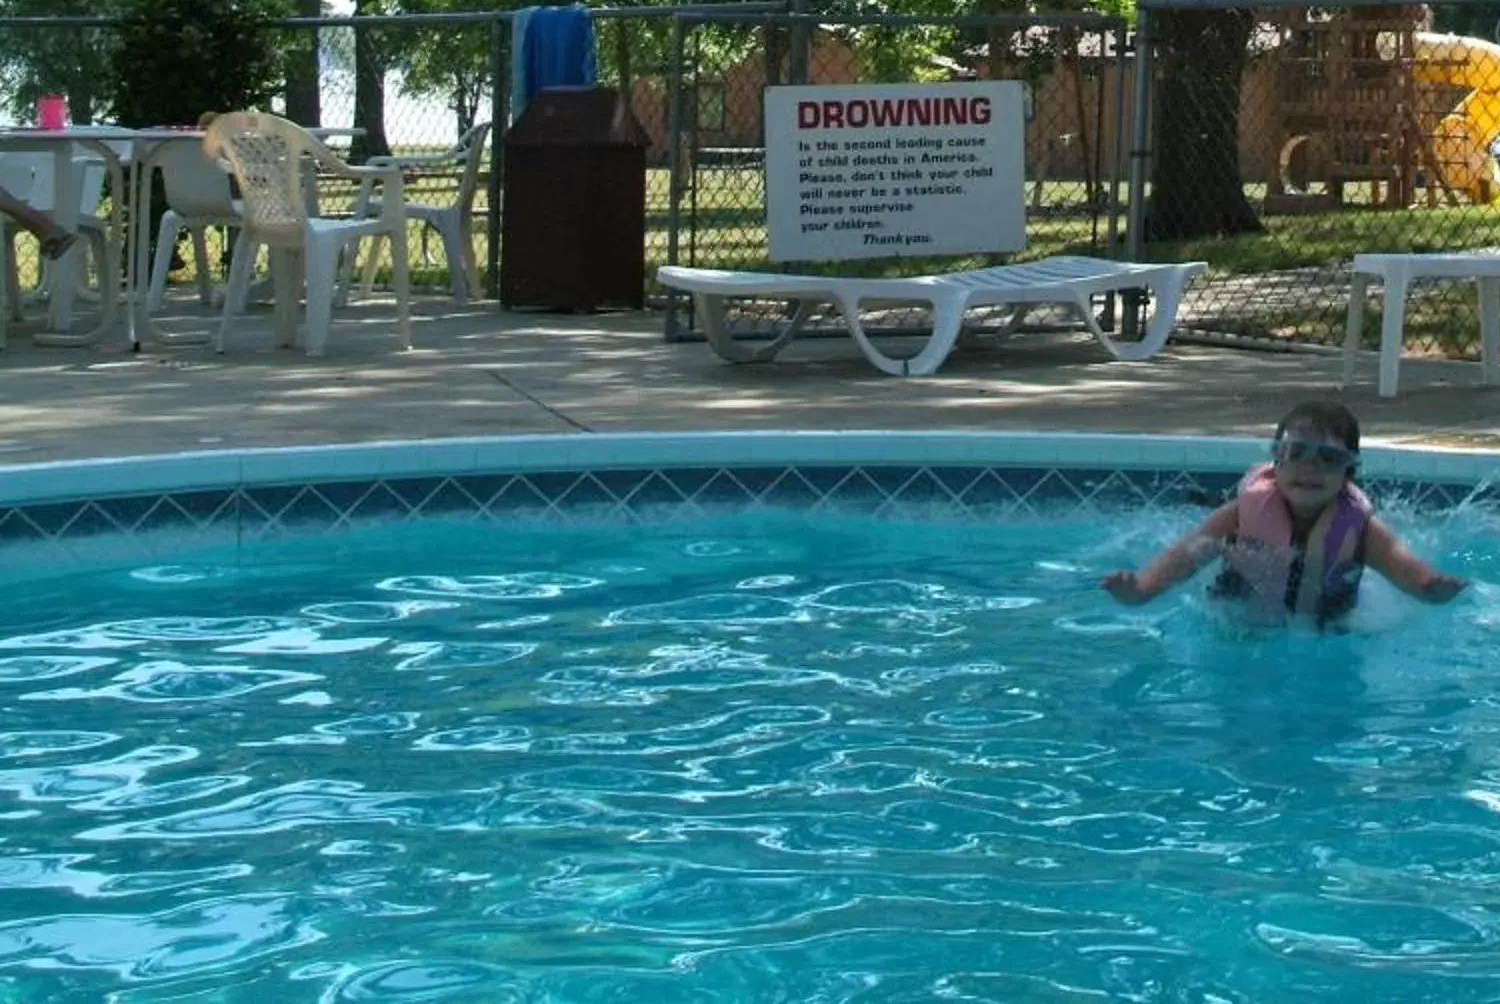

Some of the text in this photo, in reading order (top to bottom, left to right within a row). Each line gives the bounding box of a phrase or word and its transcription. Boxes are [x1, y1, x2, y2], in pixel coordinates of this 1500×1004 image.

[798, 97, 991, 129] DROWNING
[816, 140, 838, 151] the
[844, 138, 891, 150] second
[895, 137, 943, 149] leading
[948, 138, 985, 148] cause
[799, 156, 813, 168] of
[818, 155, 848, 167] child
[853, 154, 898, 166] deaths
[904, 154, 915, 165] in
[851, 170, 884, 182] don't
[891, 168, 923, 180] think
[929, 169, 958, 181] your
[963, 167, 993, 178] child
[799, 187, 823, 200] will
[828, 188, 865, 199] never
[871, 186, 886, 197] be
[892, 187, 901, 197] a
[799, 201, 914, 215] Please supervise
[800, 221, 829, 233] your
[863, 233, 903, 245] Thank
